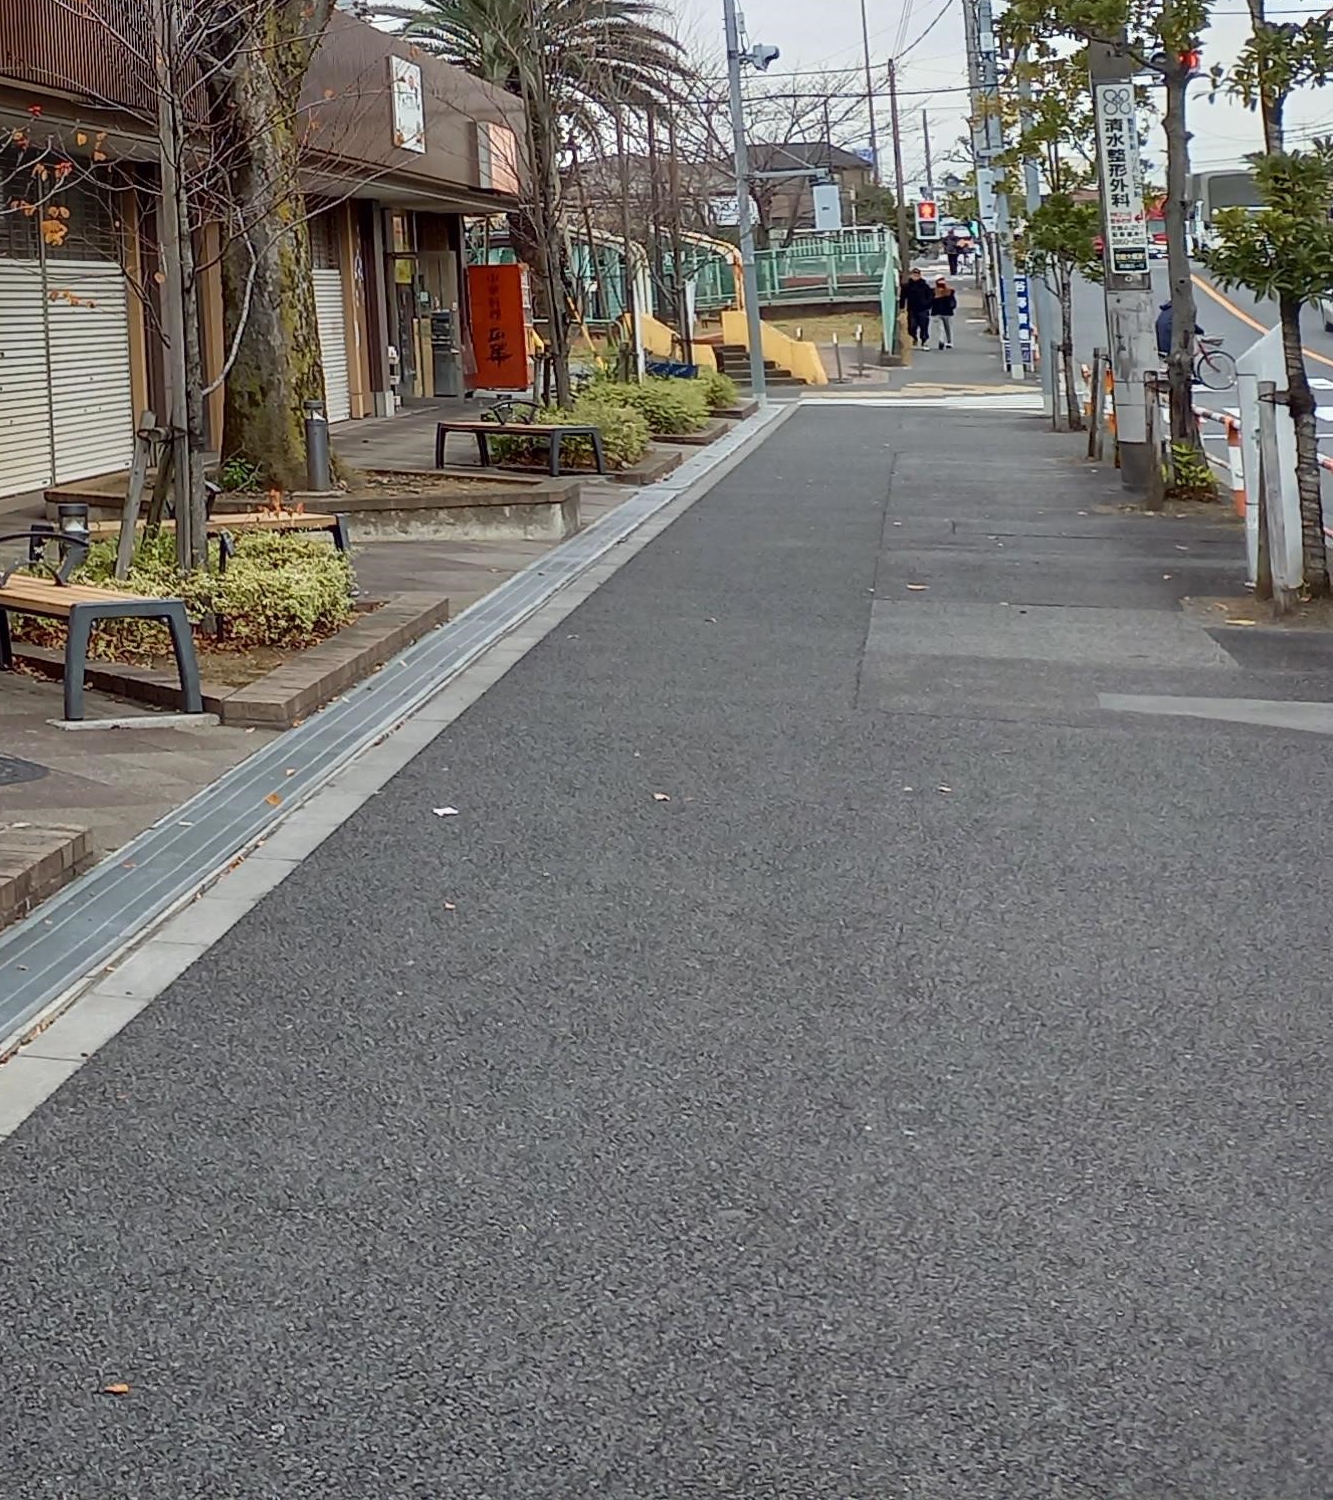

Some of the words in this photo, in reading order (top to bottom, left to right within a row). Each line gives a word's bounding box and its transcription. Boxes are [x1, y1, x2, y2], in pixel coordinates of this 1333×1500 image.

[1105, 118, 1131, 207] 清水整形外科
